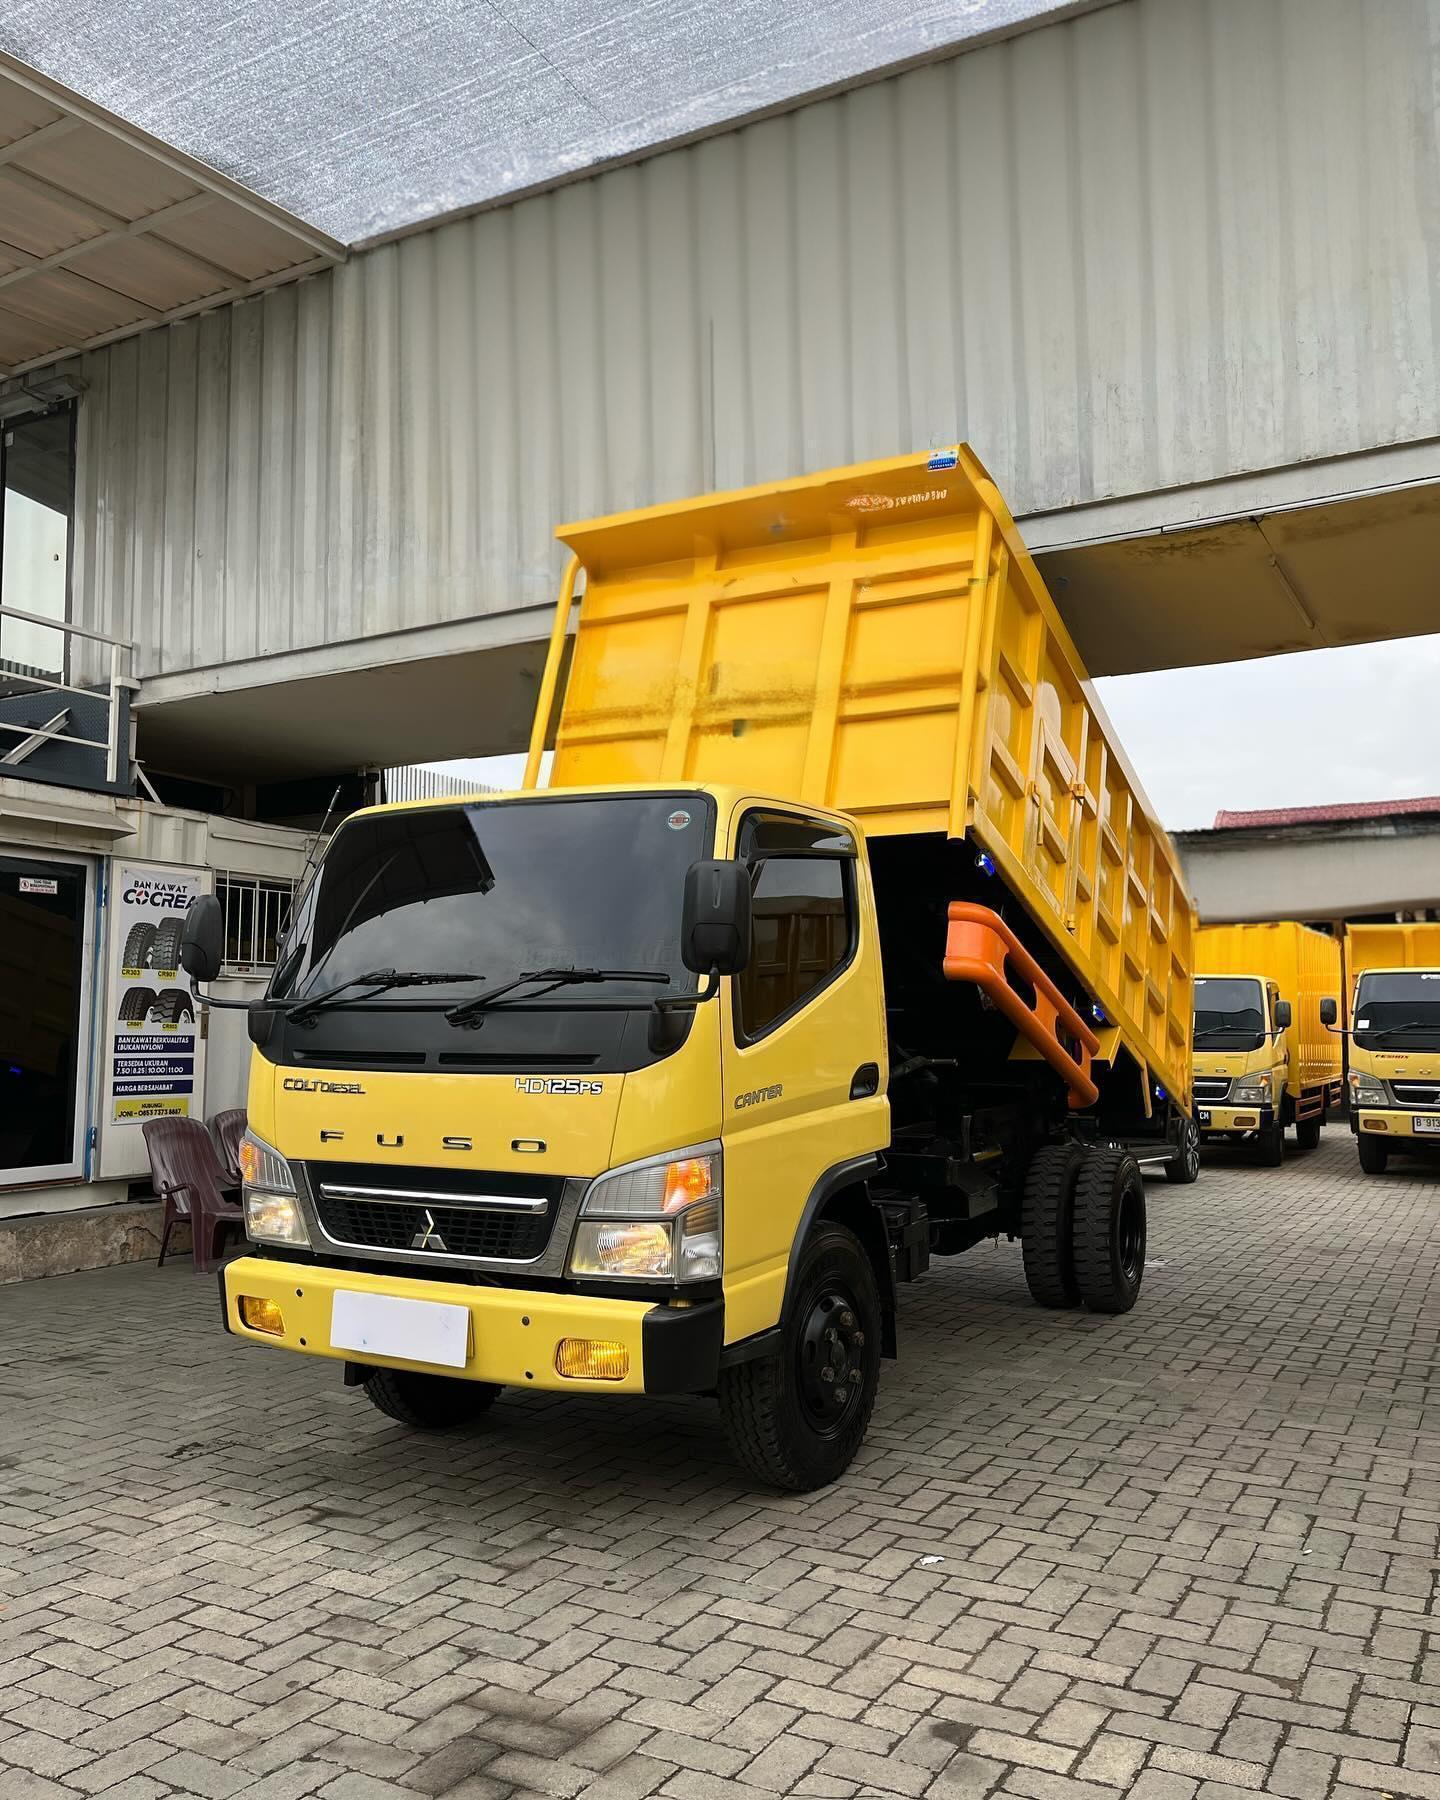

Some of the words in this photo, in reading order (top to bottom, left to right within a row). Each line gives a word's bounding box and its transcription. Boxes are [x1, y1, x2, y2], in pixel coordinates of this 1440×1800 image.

[134, 880, 151, 889] BAN
[154, 883, 188, 893] KAWAT
[118, 1036, 130, 1044] BAN
[131, 1036, 152, 1044] KAWAT
[152, 1036, 189, 1044] BERKUALITAS
[734, 1083, 783, 1109] CANTER
[1416, 1118, 1422, 1126] B
[320, 1128, 547, 1153] FUSO
